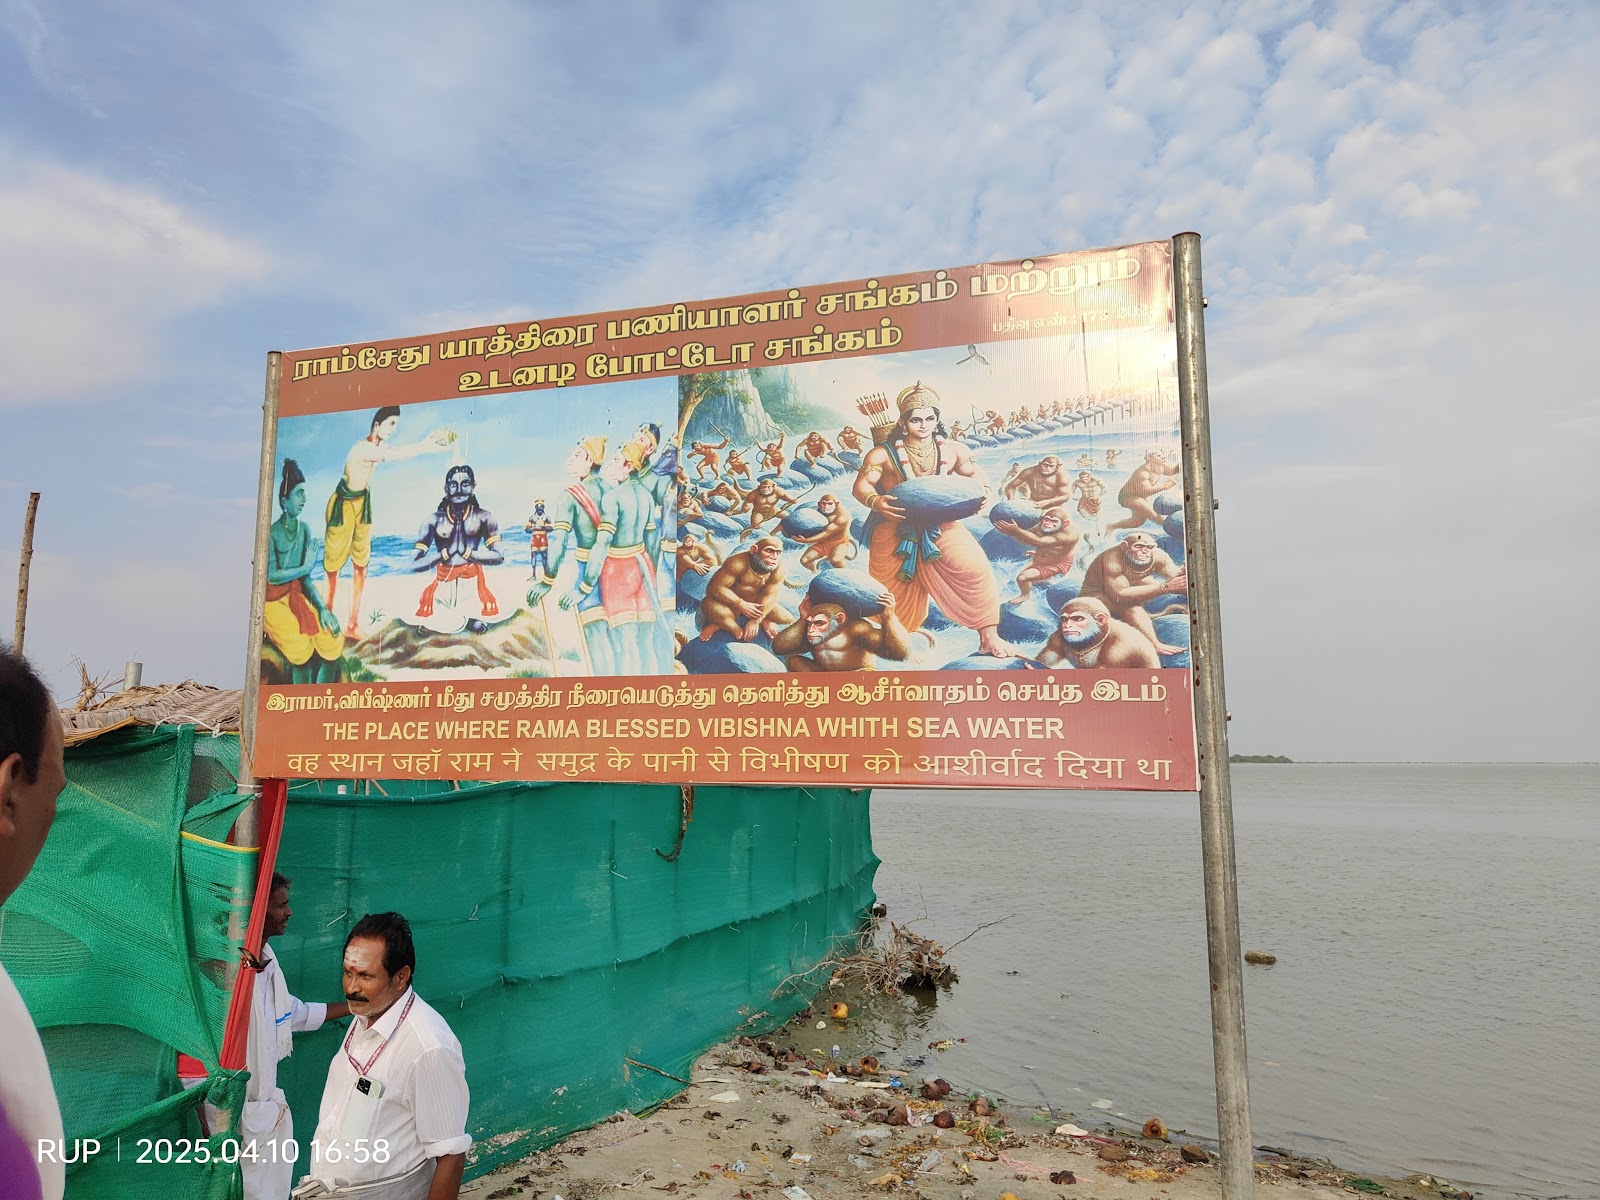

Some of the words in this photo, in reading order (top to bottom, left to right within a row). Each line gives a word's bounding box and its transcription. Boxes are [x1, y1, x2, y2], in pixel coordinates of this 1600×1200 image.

[292, 344, 430, 381] ராம்சேது
[439, 323, 598, 360] யாத்திரை
[607, 289, 807, 340] பணியாளர்
[816, 271, 959, 315] சங்கம்
[970, 249, 1141, 302] மற்றும்
[458, 362, 576, 391] உடனடி
[585, 342, 755, 378] போட்டோ
[764, 317, 903, 360] சங்கம்
[437, 686, 475, 712] மீது
[480, 684, 562, 711] சமுத்திர
[566, 681, 717, 711] நீரையெடுத்து
[723, 679, 830, 709] தெளித்து
[836, 676, 990, 707] ஆசீர்வாதம்
[997, 675, 1083, 707] செய்த
[1090, 675, 1167, 703] இடம்
[323, 721, 359, 741] THE
[364, 721, 430, 741] PLACE
[436, 720, 509, 740] WHERE
[516, 719, 580, 739] RAMA
[586, 718, 691, 738] BLESSED
[698, 717, 810, 738] VIBISHNA
[817, 717, 898, 738] WHITH
[907, 717, 960, 739] SEA
[967, 717, 1065, 740] WATER
[287, 753, 321, 775] वह
[328, 753, 385, 772] स्थान
[448, 752, 494, 772] राम
[501, 748, 523, 772] ने
[536, 752, 599, 777] समुद्र
[606, 747, 634, 771] के
[642, 747, 699, 772] पानी
[706, 747, 732, 772] से
[740, 747, 850, 773] विभीषण
[862, 748, 903, 774] को
[913, 748, 1046, 779] आशीर्वाद
[1055, 750, 1125, 779] दिया
[1137, 758, 1173, 781] था
